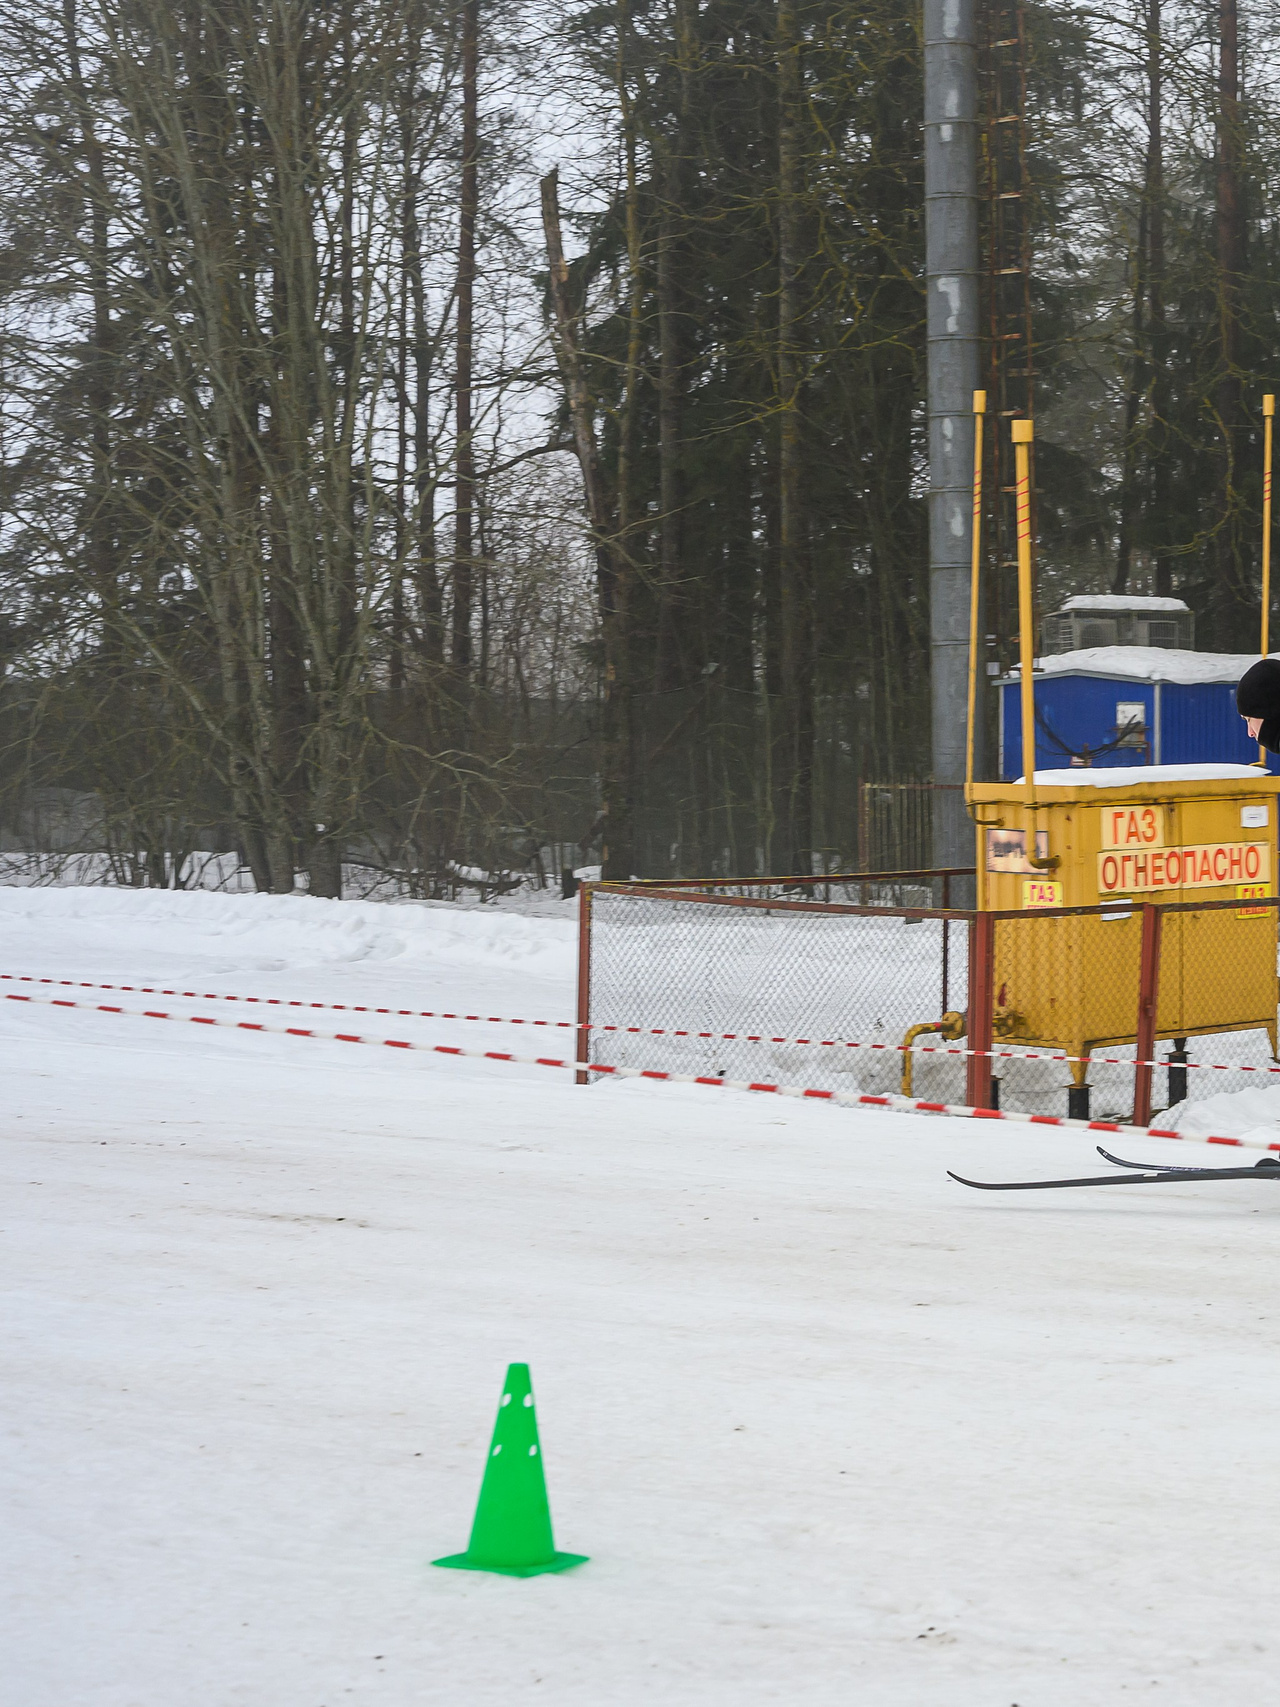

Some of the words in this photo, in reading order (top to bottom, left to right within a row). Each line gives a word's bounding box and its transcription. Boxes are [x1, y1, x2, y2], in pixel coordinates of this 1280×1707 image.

[1112, 808, 1157, 845] ГАЗ
[1102, 845, 1261, 890] ОГНЕОПАСНО
[1029, 884, 1055, 903] ГАЗ
